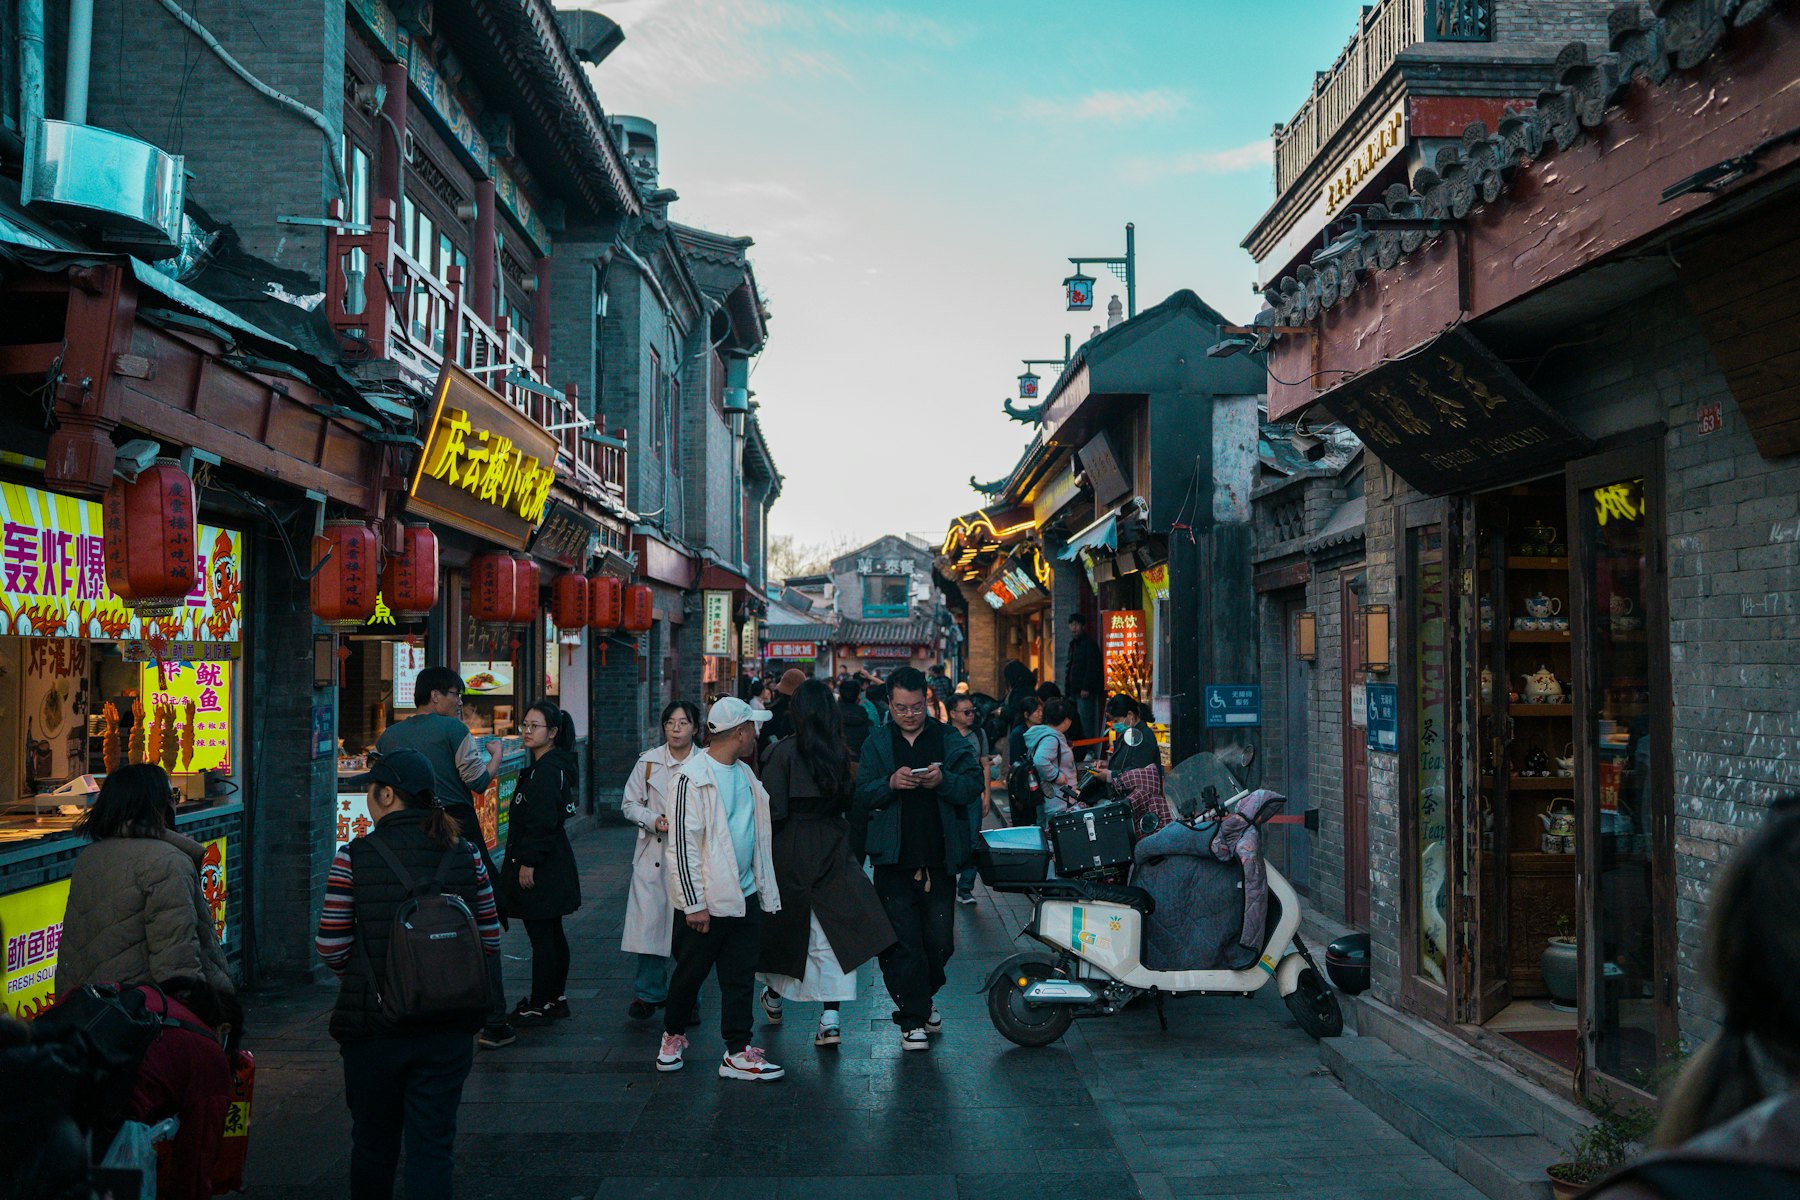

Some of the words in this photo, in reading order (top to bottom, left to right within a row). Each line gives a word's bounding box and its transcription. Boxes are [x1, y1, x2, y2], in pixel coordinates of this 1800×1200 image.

[431, 409, 556, 526] 庆云楼小吃城
[1111, 614, 1138, 630] 热饮
[1421, 751, 1445, 770] Tea
[7, 972, 35, 994] FRESH
